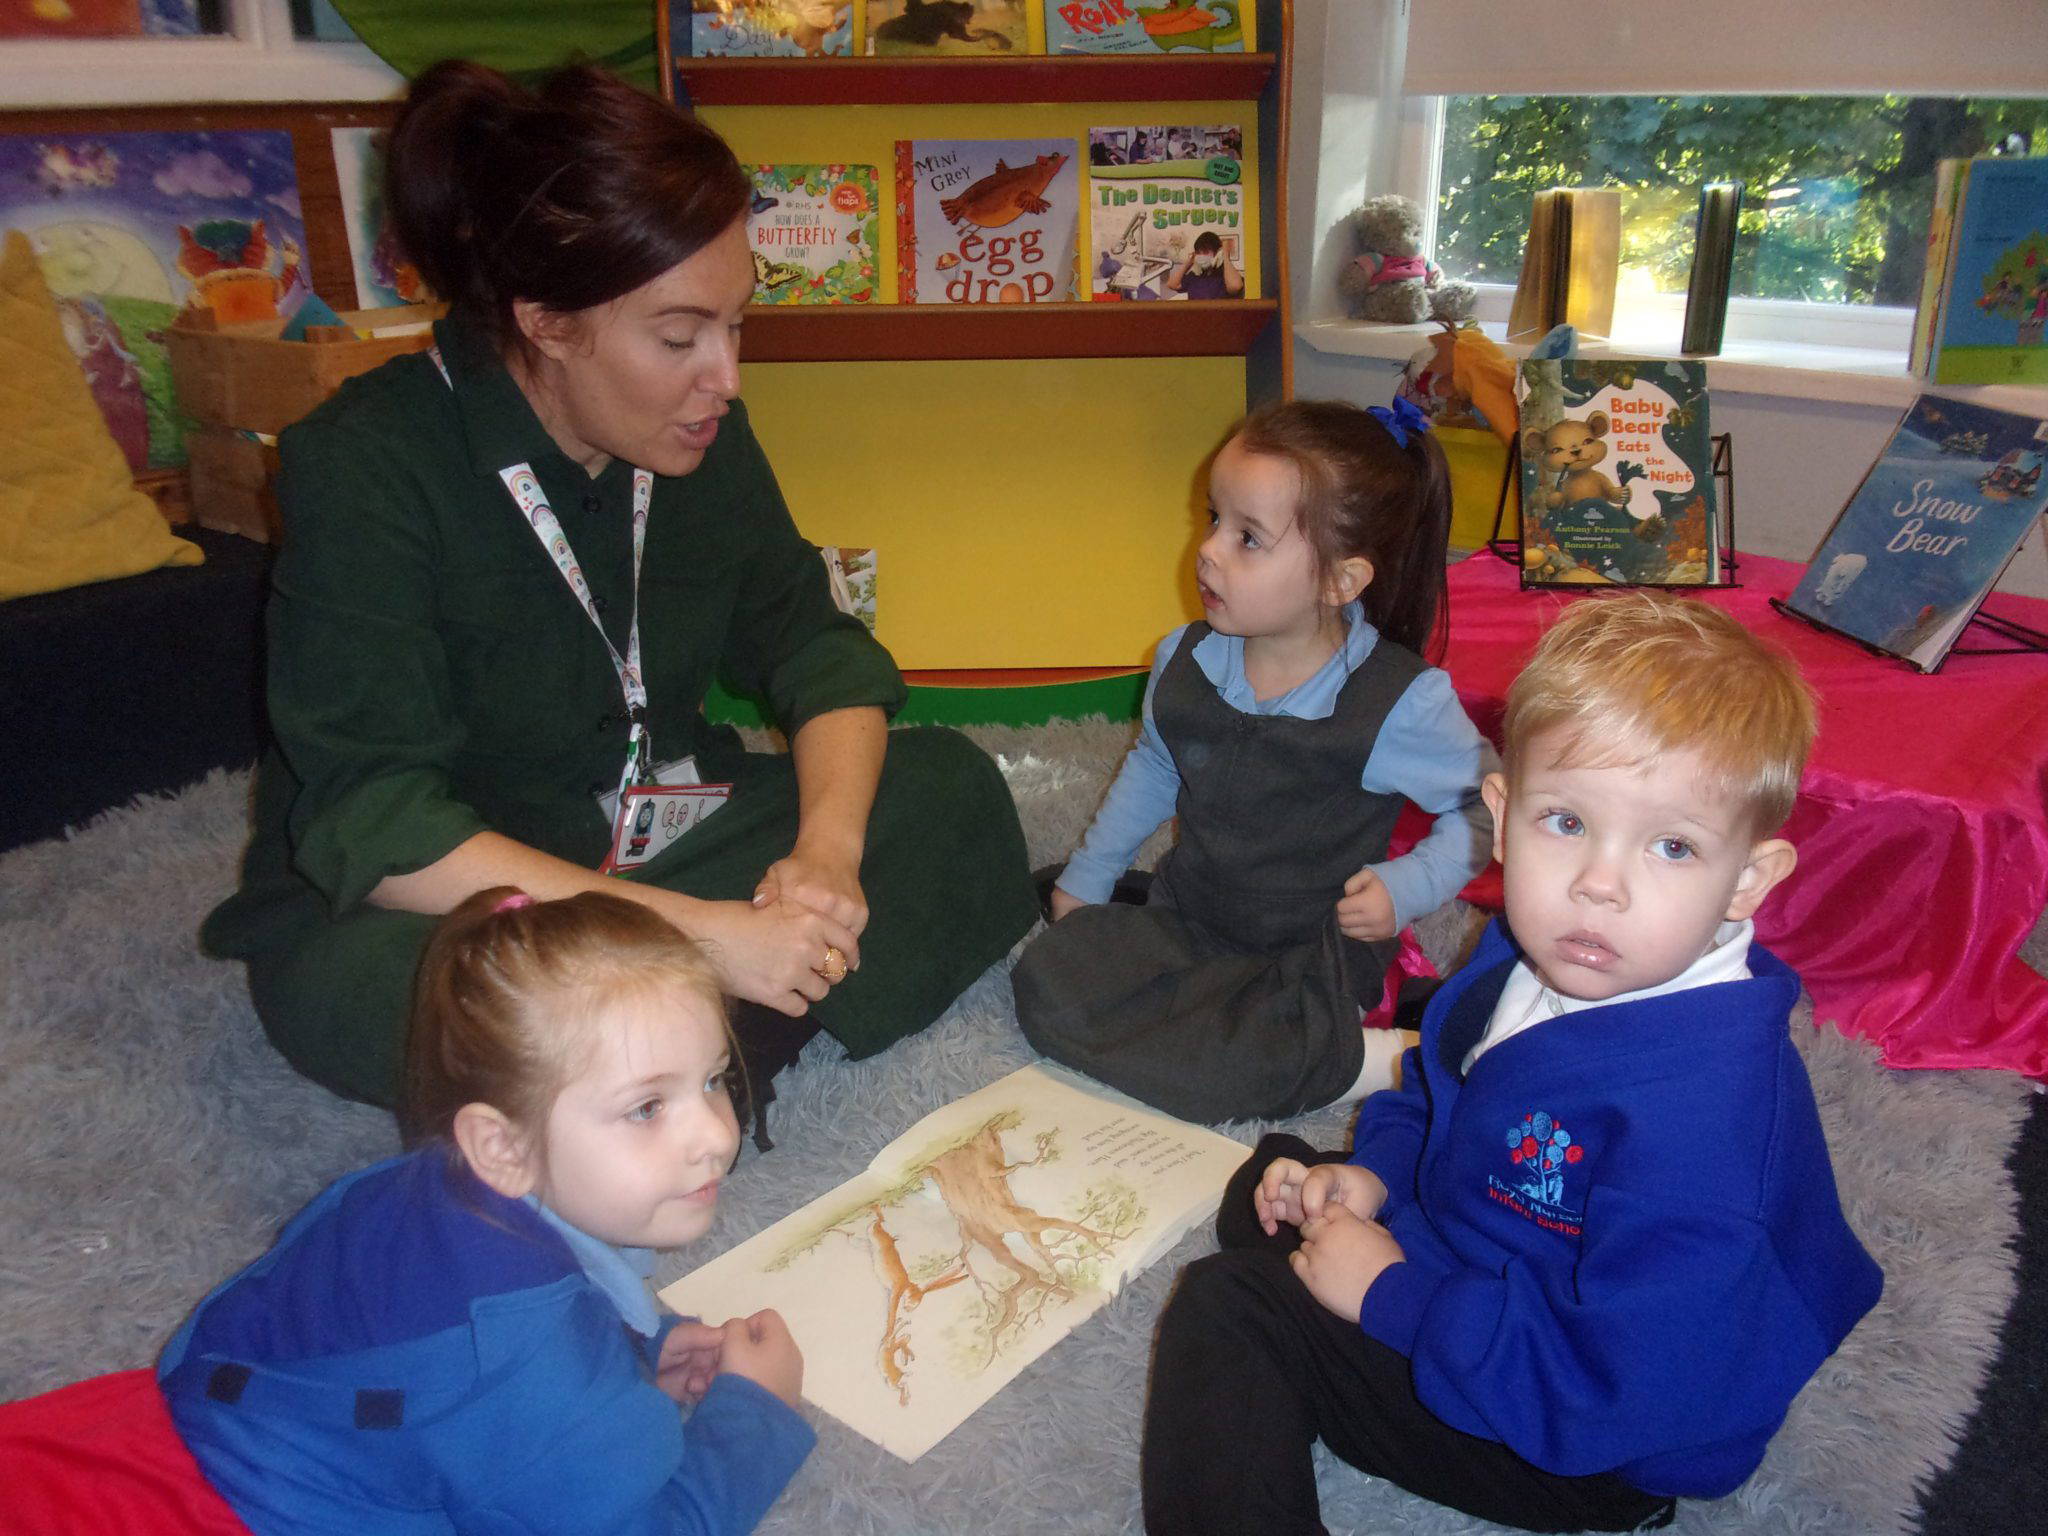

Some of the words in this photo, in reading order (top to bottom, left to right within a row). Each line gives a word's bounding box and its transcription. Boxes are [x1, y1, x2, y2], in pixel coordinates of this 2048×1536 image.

[1098, 185, 1138, 206] The
[1143, 183, 1238, 206] Dentist's
[795, 201, 812, 209] RHS
[775, 215, 792, 225] HOW
[794, 214, 812, 225] DOES
[815, 215, 821, 225] A
[1152, 208, 1239, 229] Surgery
[757, 227, 837, 245] BUTTERFLY
[785, 247, 810, 258] GROW?
[959, 229, 1044, 276] egg
[1610, 397, 1664, 417] Baby
[1611, 418, 1661, 434] Bear
[1616, 440, 1650, 452] Eats
[1645, 457, 1665, 466] the
[1650, 470, 1693, 484] Night
[1893, 479, 1983, 524] Snow
[1555, 525, 1592, 534] Anthony
[1886, 518, 1969, 556] Bear
